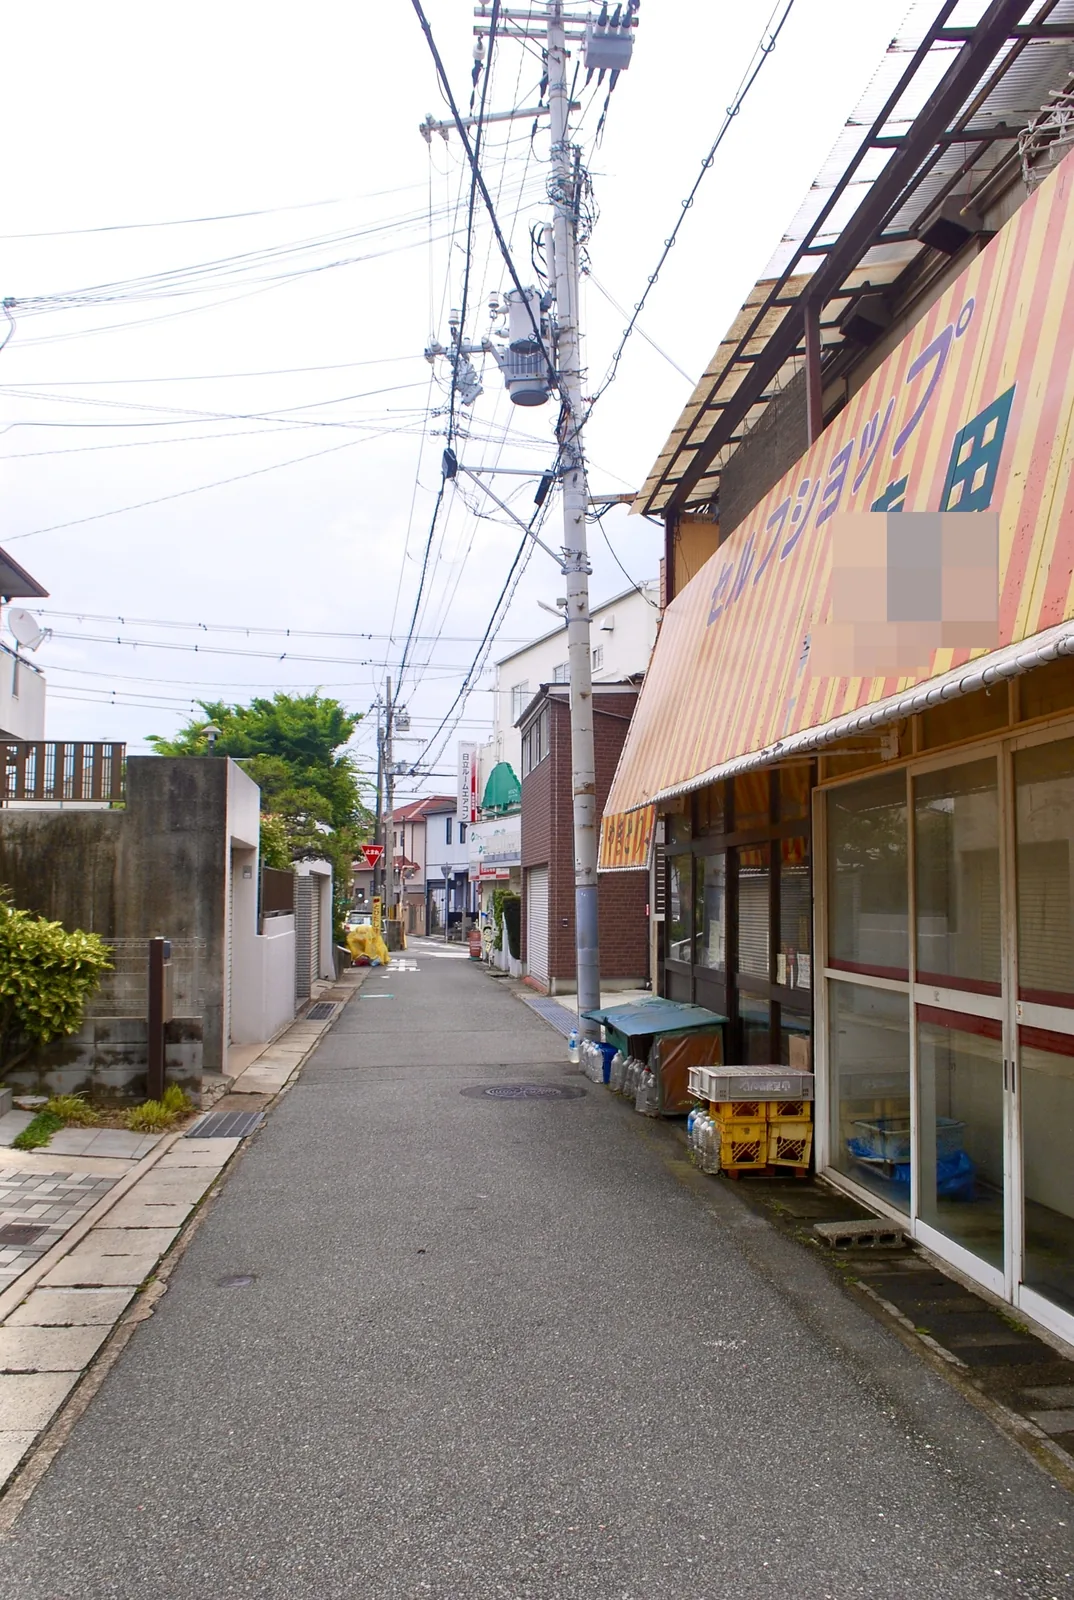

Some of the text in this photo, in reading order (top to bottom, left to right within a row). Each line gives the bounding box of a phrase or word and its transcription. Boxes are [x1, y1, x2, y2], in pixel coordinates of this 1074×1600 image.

[706, 297, 976, 628] セルフショップ
[462, 753, 470, 820] 日立ルームエアコン
[608, 815, 644, 857] やきとり
